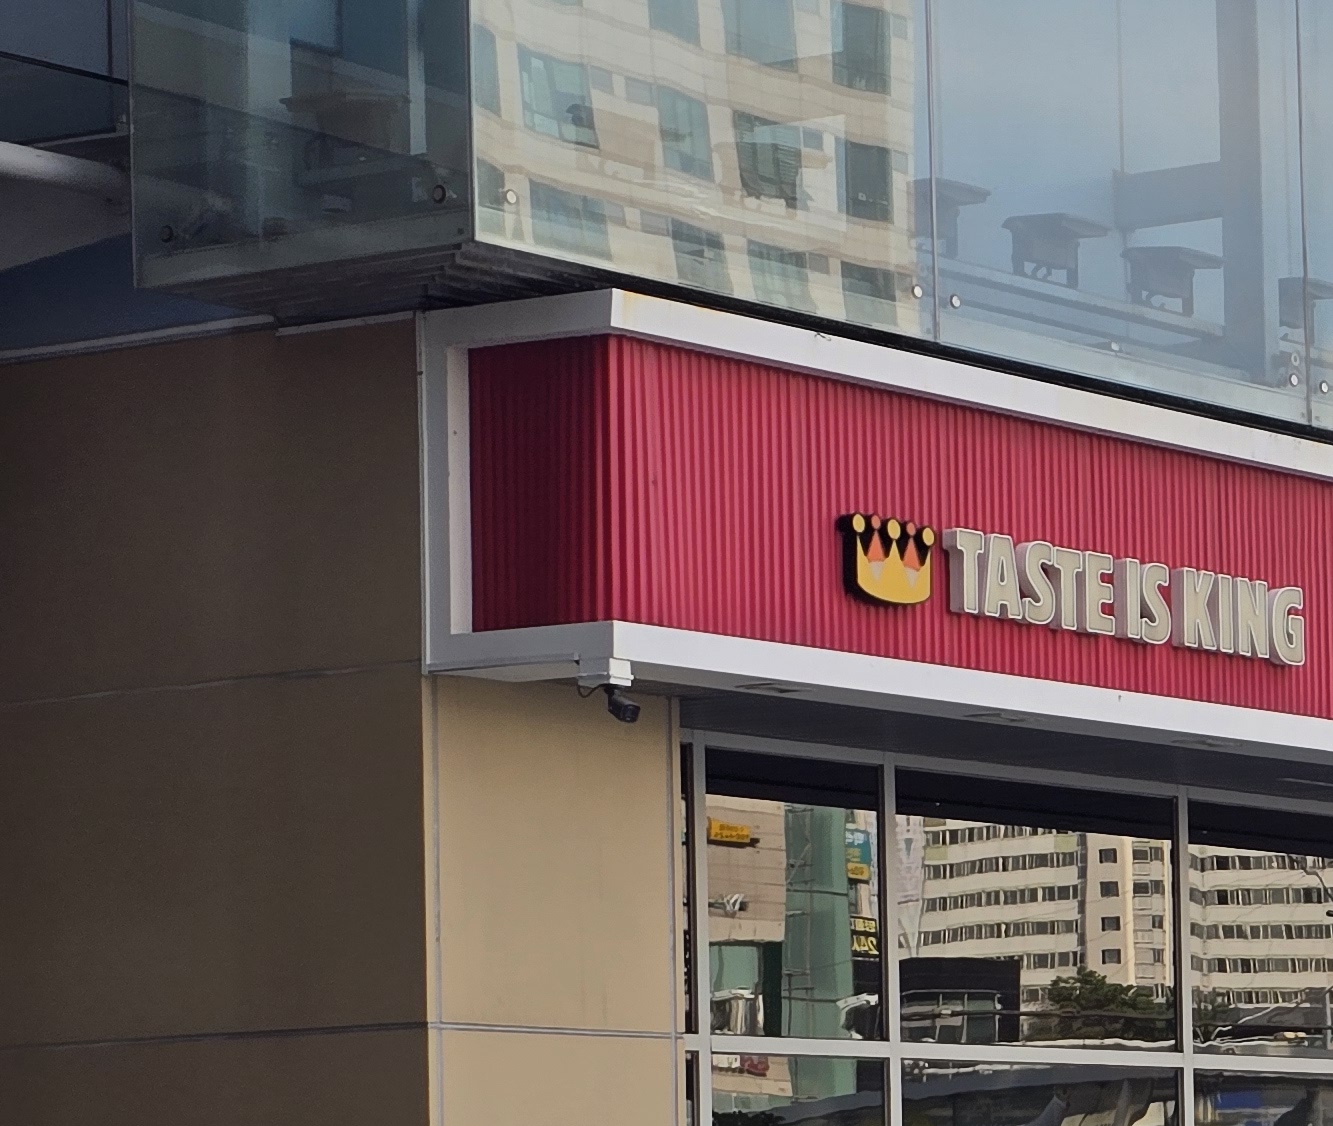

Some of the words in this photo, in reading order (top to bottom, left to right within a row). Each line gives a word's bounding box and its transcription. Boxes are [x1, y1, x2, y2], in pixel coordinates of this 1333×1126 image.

[943, 526, 1115, 636] TASTE
[1115, 556, 1172, 645] IS
[1173, 566, 1307, 667] KING
